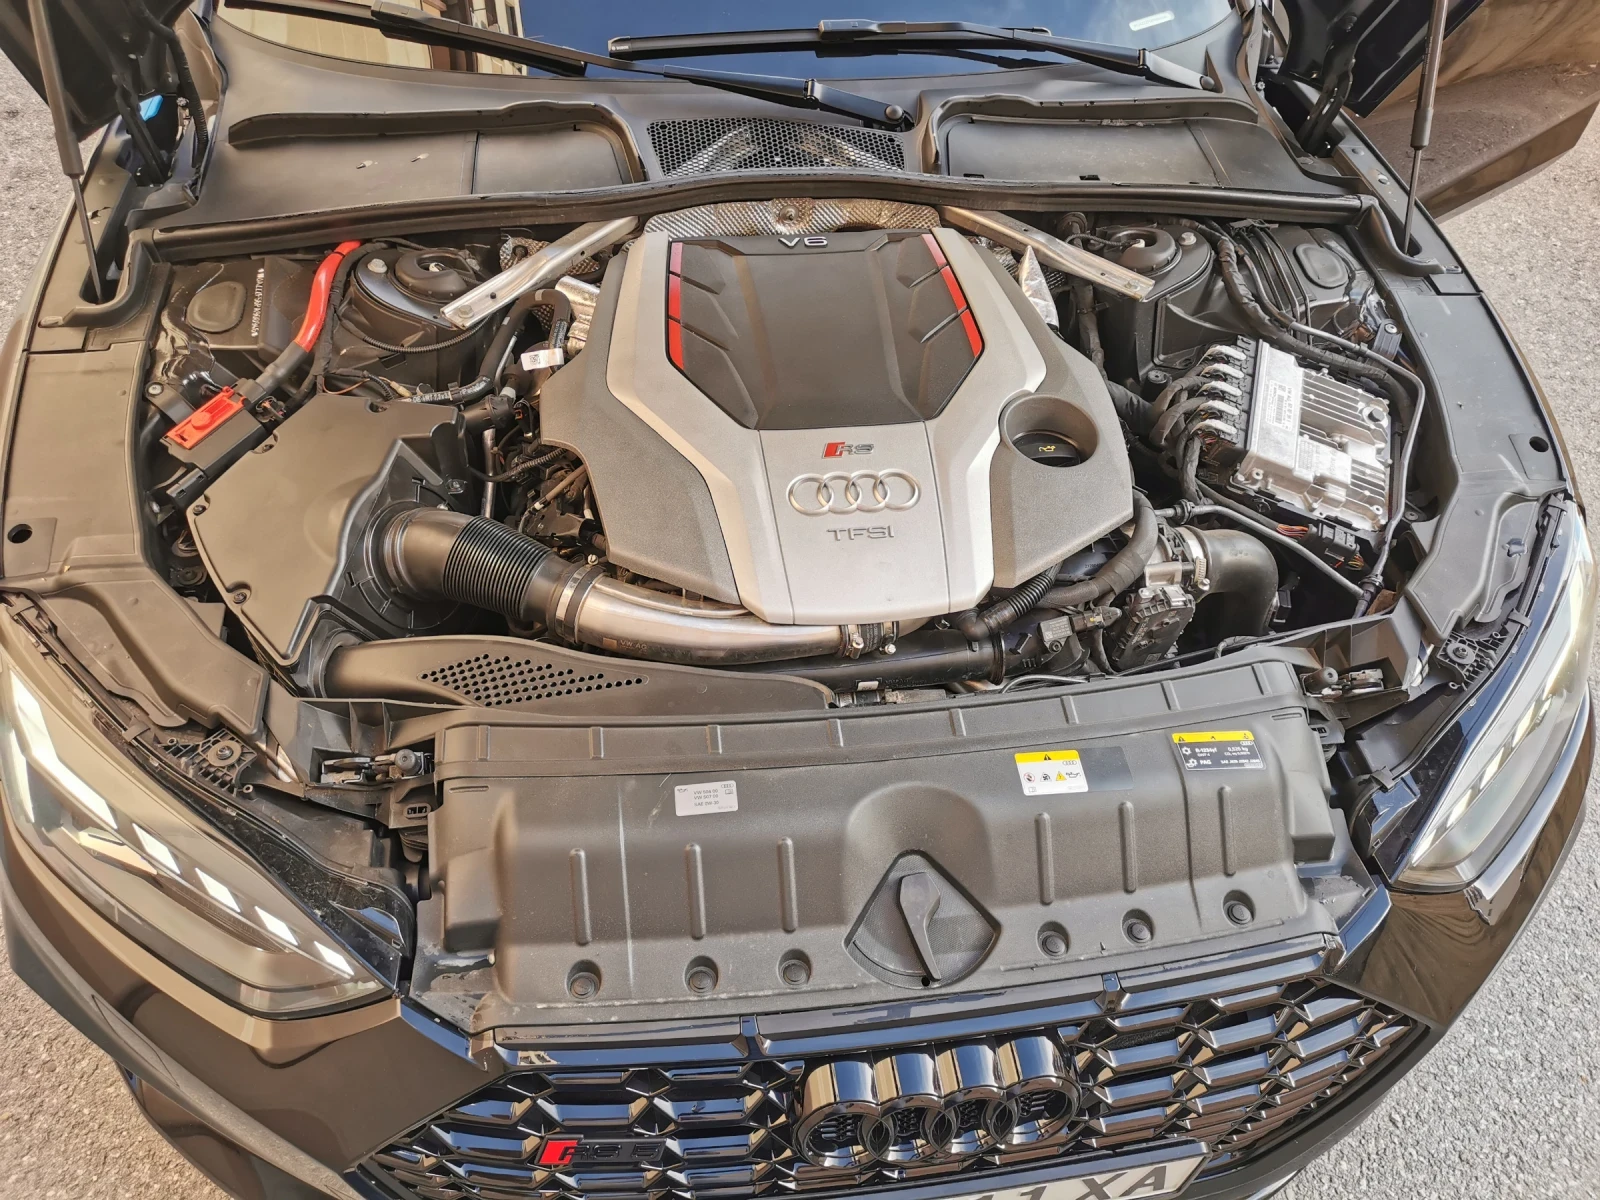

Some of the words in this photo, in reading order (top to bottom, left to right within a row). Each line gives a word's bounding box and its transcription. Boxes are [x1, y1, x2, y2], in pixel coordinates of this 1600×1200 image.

[778, 236, 828, 249] V6
[829, 442, 875, 457] RS
[826, 525, 894, 541] TFSI
[551, 1142, 623, 1162] RS
